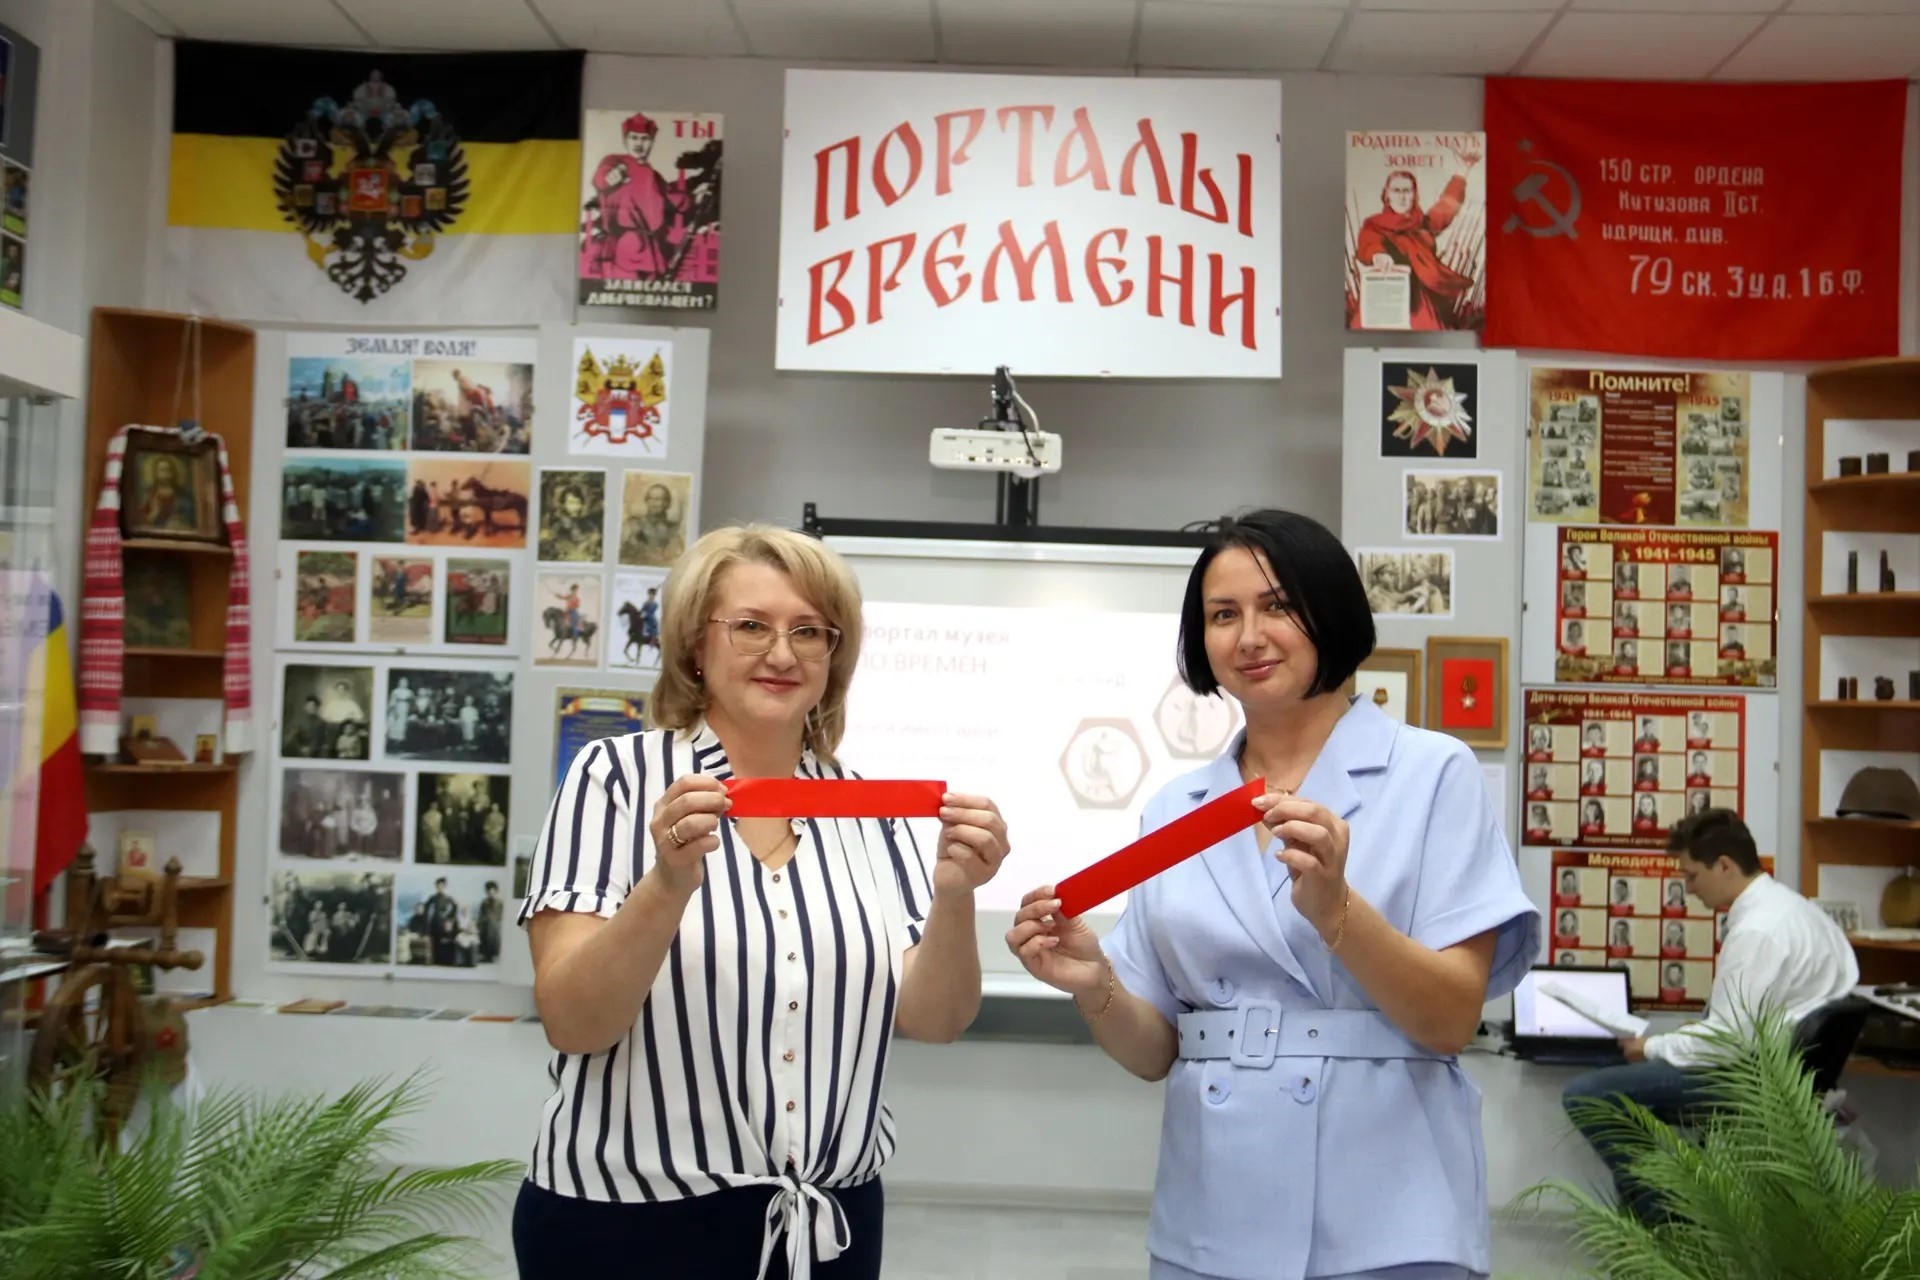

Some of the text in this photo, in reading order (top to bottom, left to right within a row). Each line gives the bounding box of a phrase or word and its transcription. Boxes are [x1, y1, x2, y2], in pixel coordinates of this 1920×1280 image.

[672, 119, 715, 139] ТЫ
[1351, 134, 1421, 150] РОДИНА
[813, 104, 1254, 239] ПОРТАЛЫ
[1598, 157, 1632, 183] 150
[1694, 164, 1765, 187] ОРДЕНА
[806, 219, 1258, 352] ВРЕМЕНИ
[1628, 253, 1674, 295] 79
[1589, 370, 1691, 394] Помните!
[1566, 528, 1769, 545] Герои Великой Отечественной войны
[1588, 692, 1630, 706] Великой
